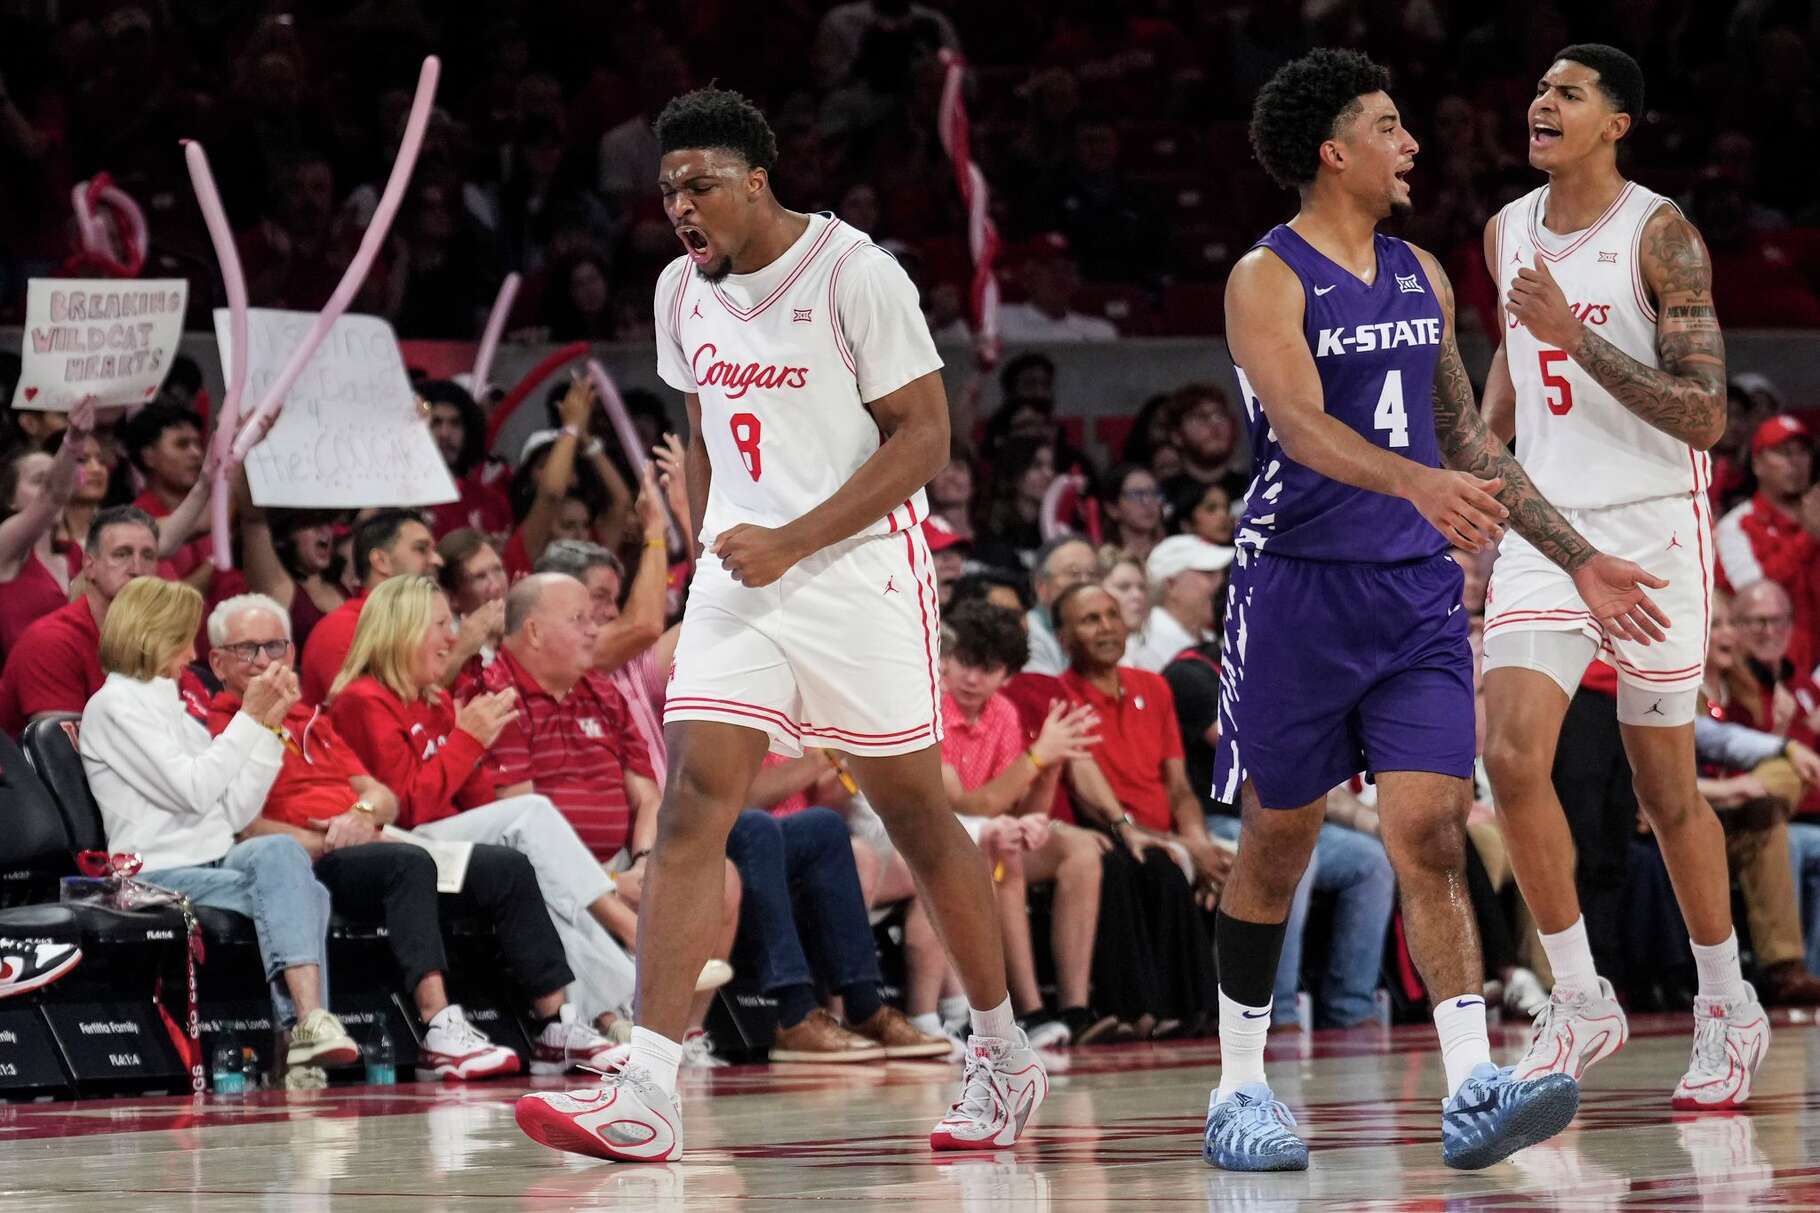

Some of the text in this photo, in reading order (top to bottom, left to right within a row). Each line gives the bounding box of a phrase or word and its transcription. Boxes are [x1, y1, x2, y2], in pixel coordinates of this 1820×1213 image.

[50, 290, 181, 322] BREAKING
[31, 322, 153, 353] WILDCAT
[1316, 318, 1440, 357] K-STATE
[64, 347, 163, 382] HEARTS
[693, 343, 809, 399] Cougars
[1538, 350, 1573, 415] 5
[1374, 369, 1409, 448] 4
[729, 413, 761, 482] 8
[109, 1020, 138, 1034] Family
